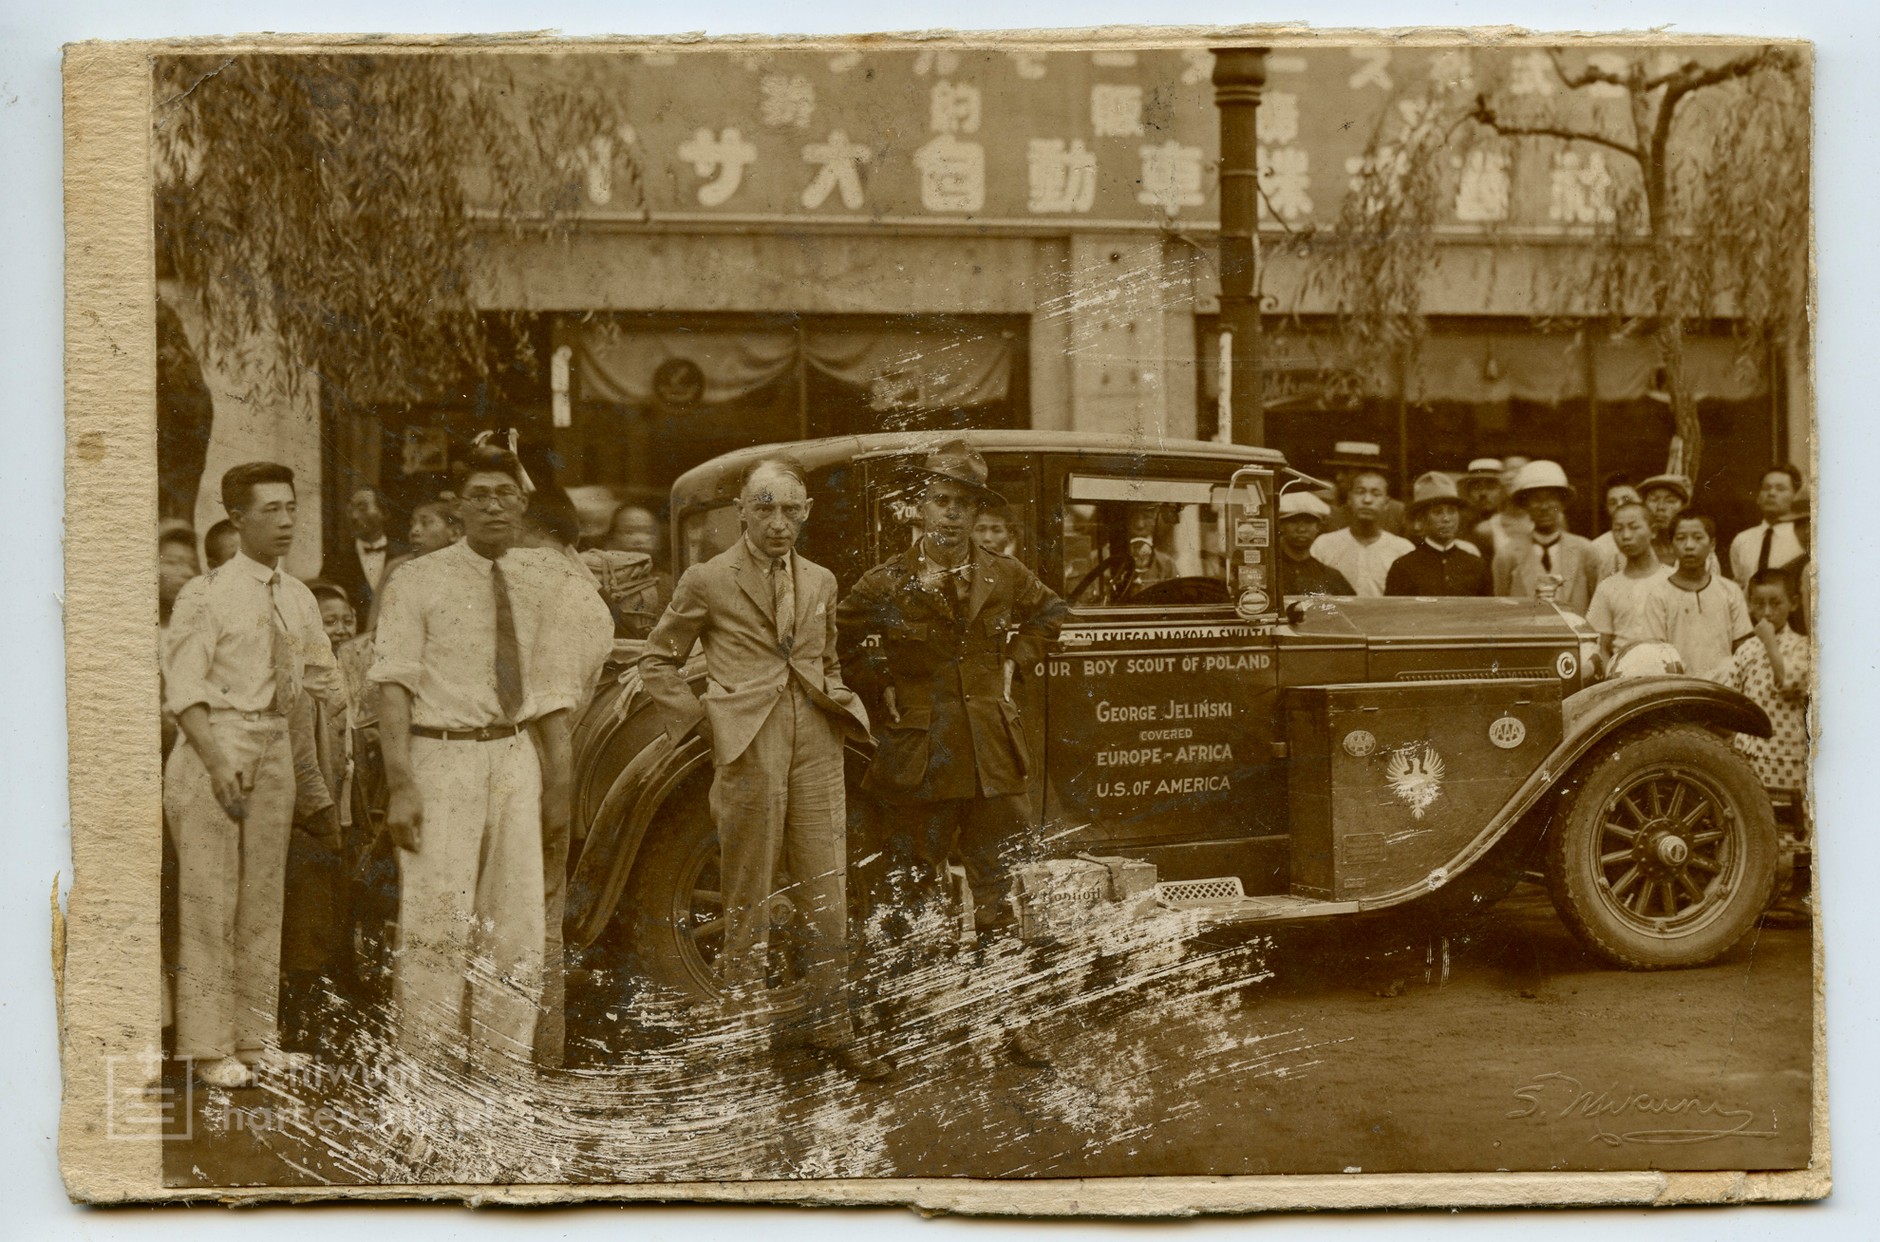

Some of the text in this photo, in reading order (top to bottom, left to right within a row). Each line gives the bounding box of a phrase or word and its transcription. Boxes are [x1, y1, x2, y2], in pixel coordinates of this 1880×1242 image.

[1034, 654, 1270, 677] OUR BOY SCOUT OF POLAND
[1096, 701, 1156, 722] GEORGE
[1139, 728, 1193, 741] COVERED
[1132, 780, 1151, 796] OF
[1154, 776, 1231, 795] AMERICA
